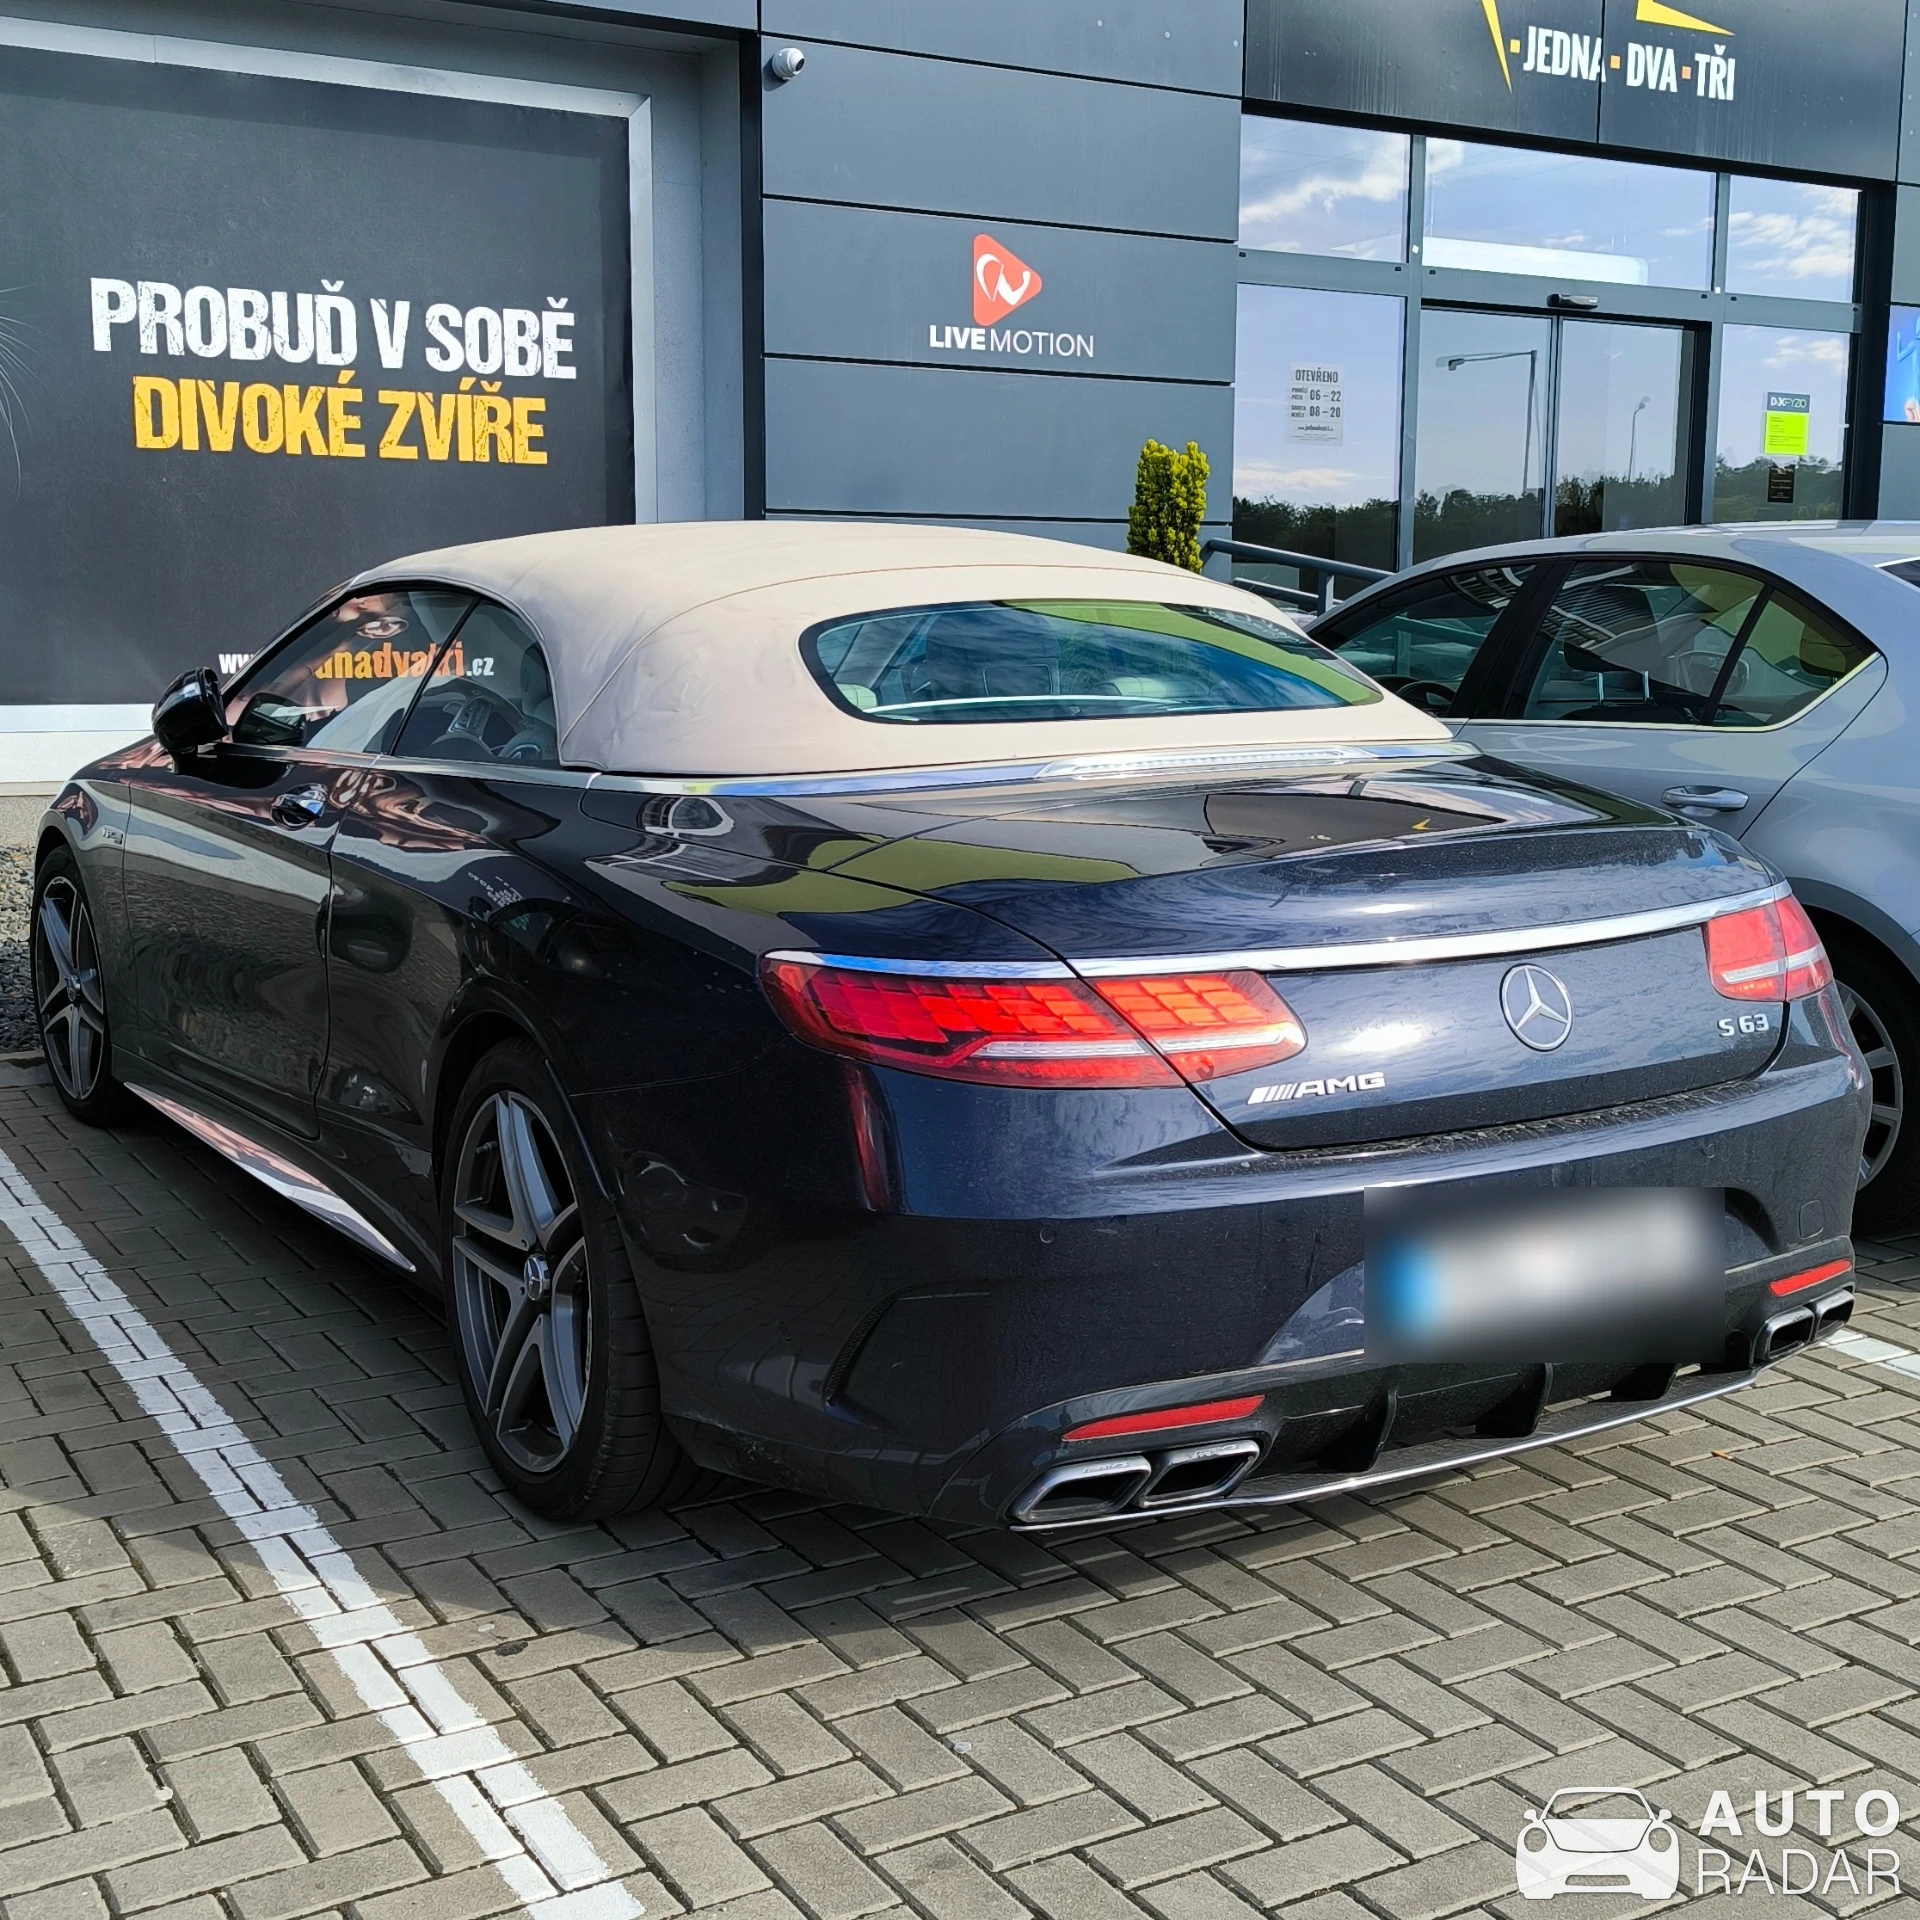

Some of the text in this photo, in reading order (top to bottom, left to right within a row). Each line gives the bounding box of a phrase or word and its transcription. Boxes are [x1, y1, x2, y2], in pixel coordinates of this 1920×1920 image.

[1523, 25, 1736, 101] JEDNA DVA TŘI
[90, 278, 577, 380] PROBUĎ V SOBĚ
[1295, 367, 1339, 383] OTEVŘENO
[1309, 389, 1321, 401] 06
[1330, 390, 1342, 402] 22
[132, 370, 549, 465] DIVOKÉ ZVÍŘE
[1309, 405, 1321, 417] 08
[1330, 406, 1341, 418] 20
[1717, 1014, 1770, 1037] S 63
[1292, 1071, 1386, 1099] AMG
